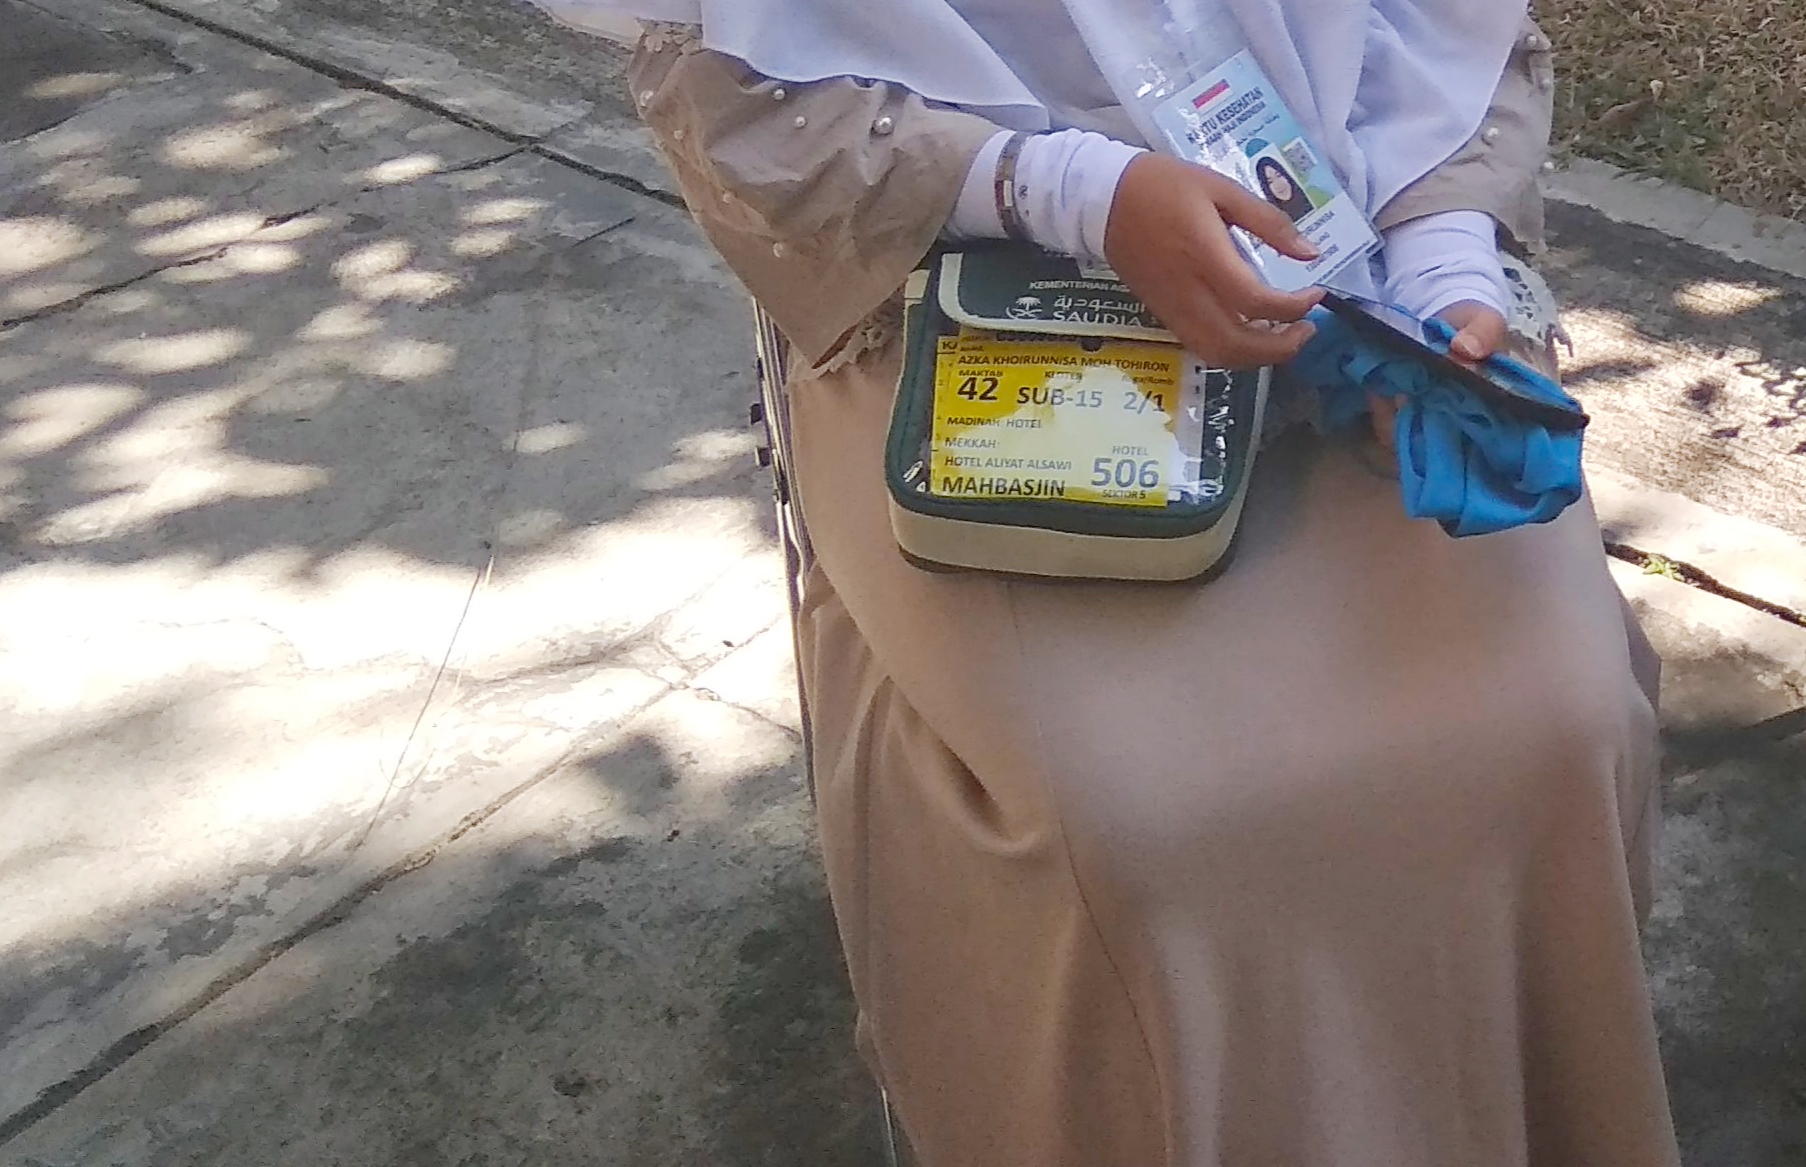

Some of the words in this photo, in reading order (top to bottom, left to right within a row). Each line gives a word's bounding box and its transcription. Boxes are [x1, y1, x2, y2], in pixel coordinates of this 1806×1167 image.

[1028, 280, 1109, 292] KEMENTERIAN
[1110, 283, 1131, 293] AG
[1053, 295, 1146, 315] السعودية
[1052, 310, 1144, 327] SAUDIA
[958, 355, 990, 365] AZKA
[993, 355, 1078, 366] KHOIRUNNISA
[957, 377, 999, 401] 42
[1016, 387, 1103, 408] SUB-15
[1123, 390, 1165, 414] 2/1
[1111, 445, 1149, 456] HOTEL
[944, 456, 982, 468] HOTEL
[1090, 457, 1160, 489] 506
[942, 476, 1066, 496] MAHBASJIN
